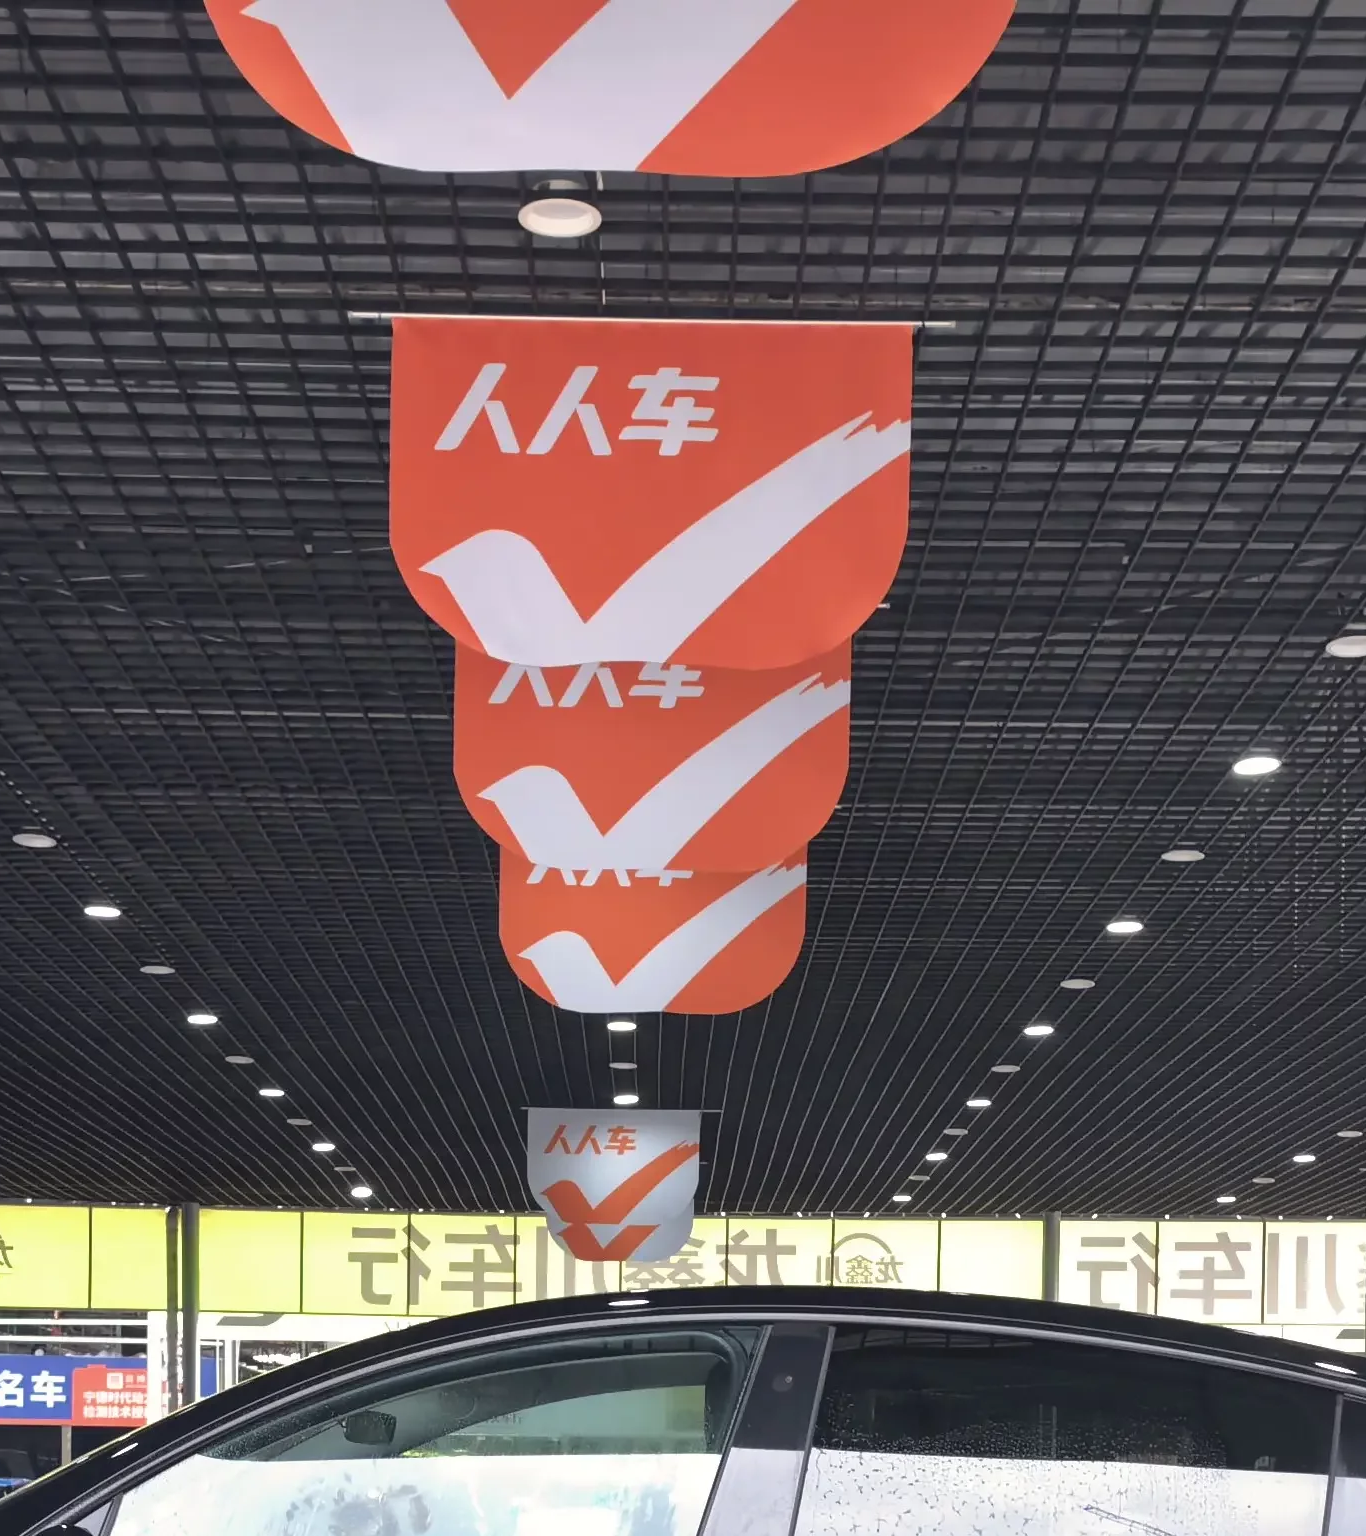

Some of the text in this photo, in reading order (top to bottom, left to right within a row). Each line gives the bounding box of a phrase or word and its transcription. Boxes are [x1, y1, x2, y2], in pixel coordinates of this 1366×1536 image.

[434, 362, 720, 456] 人人车
[543, 1125, 636, 1156] 人人车
